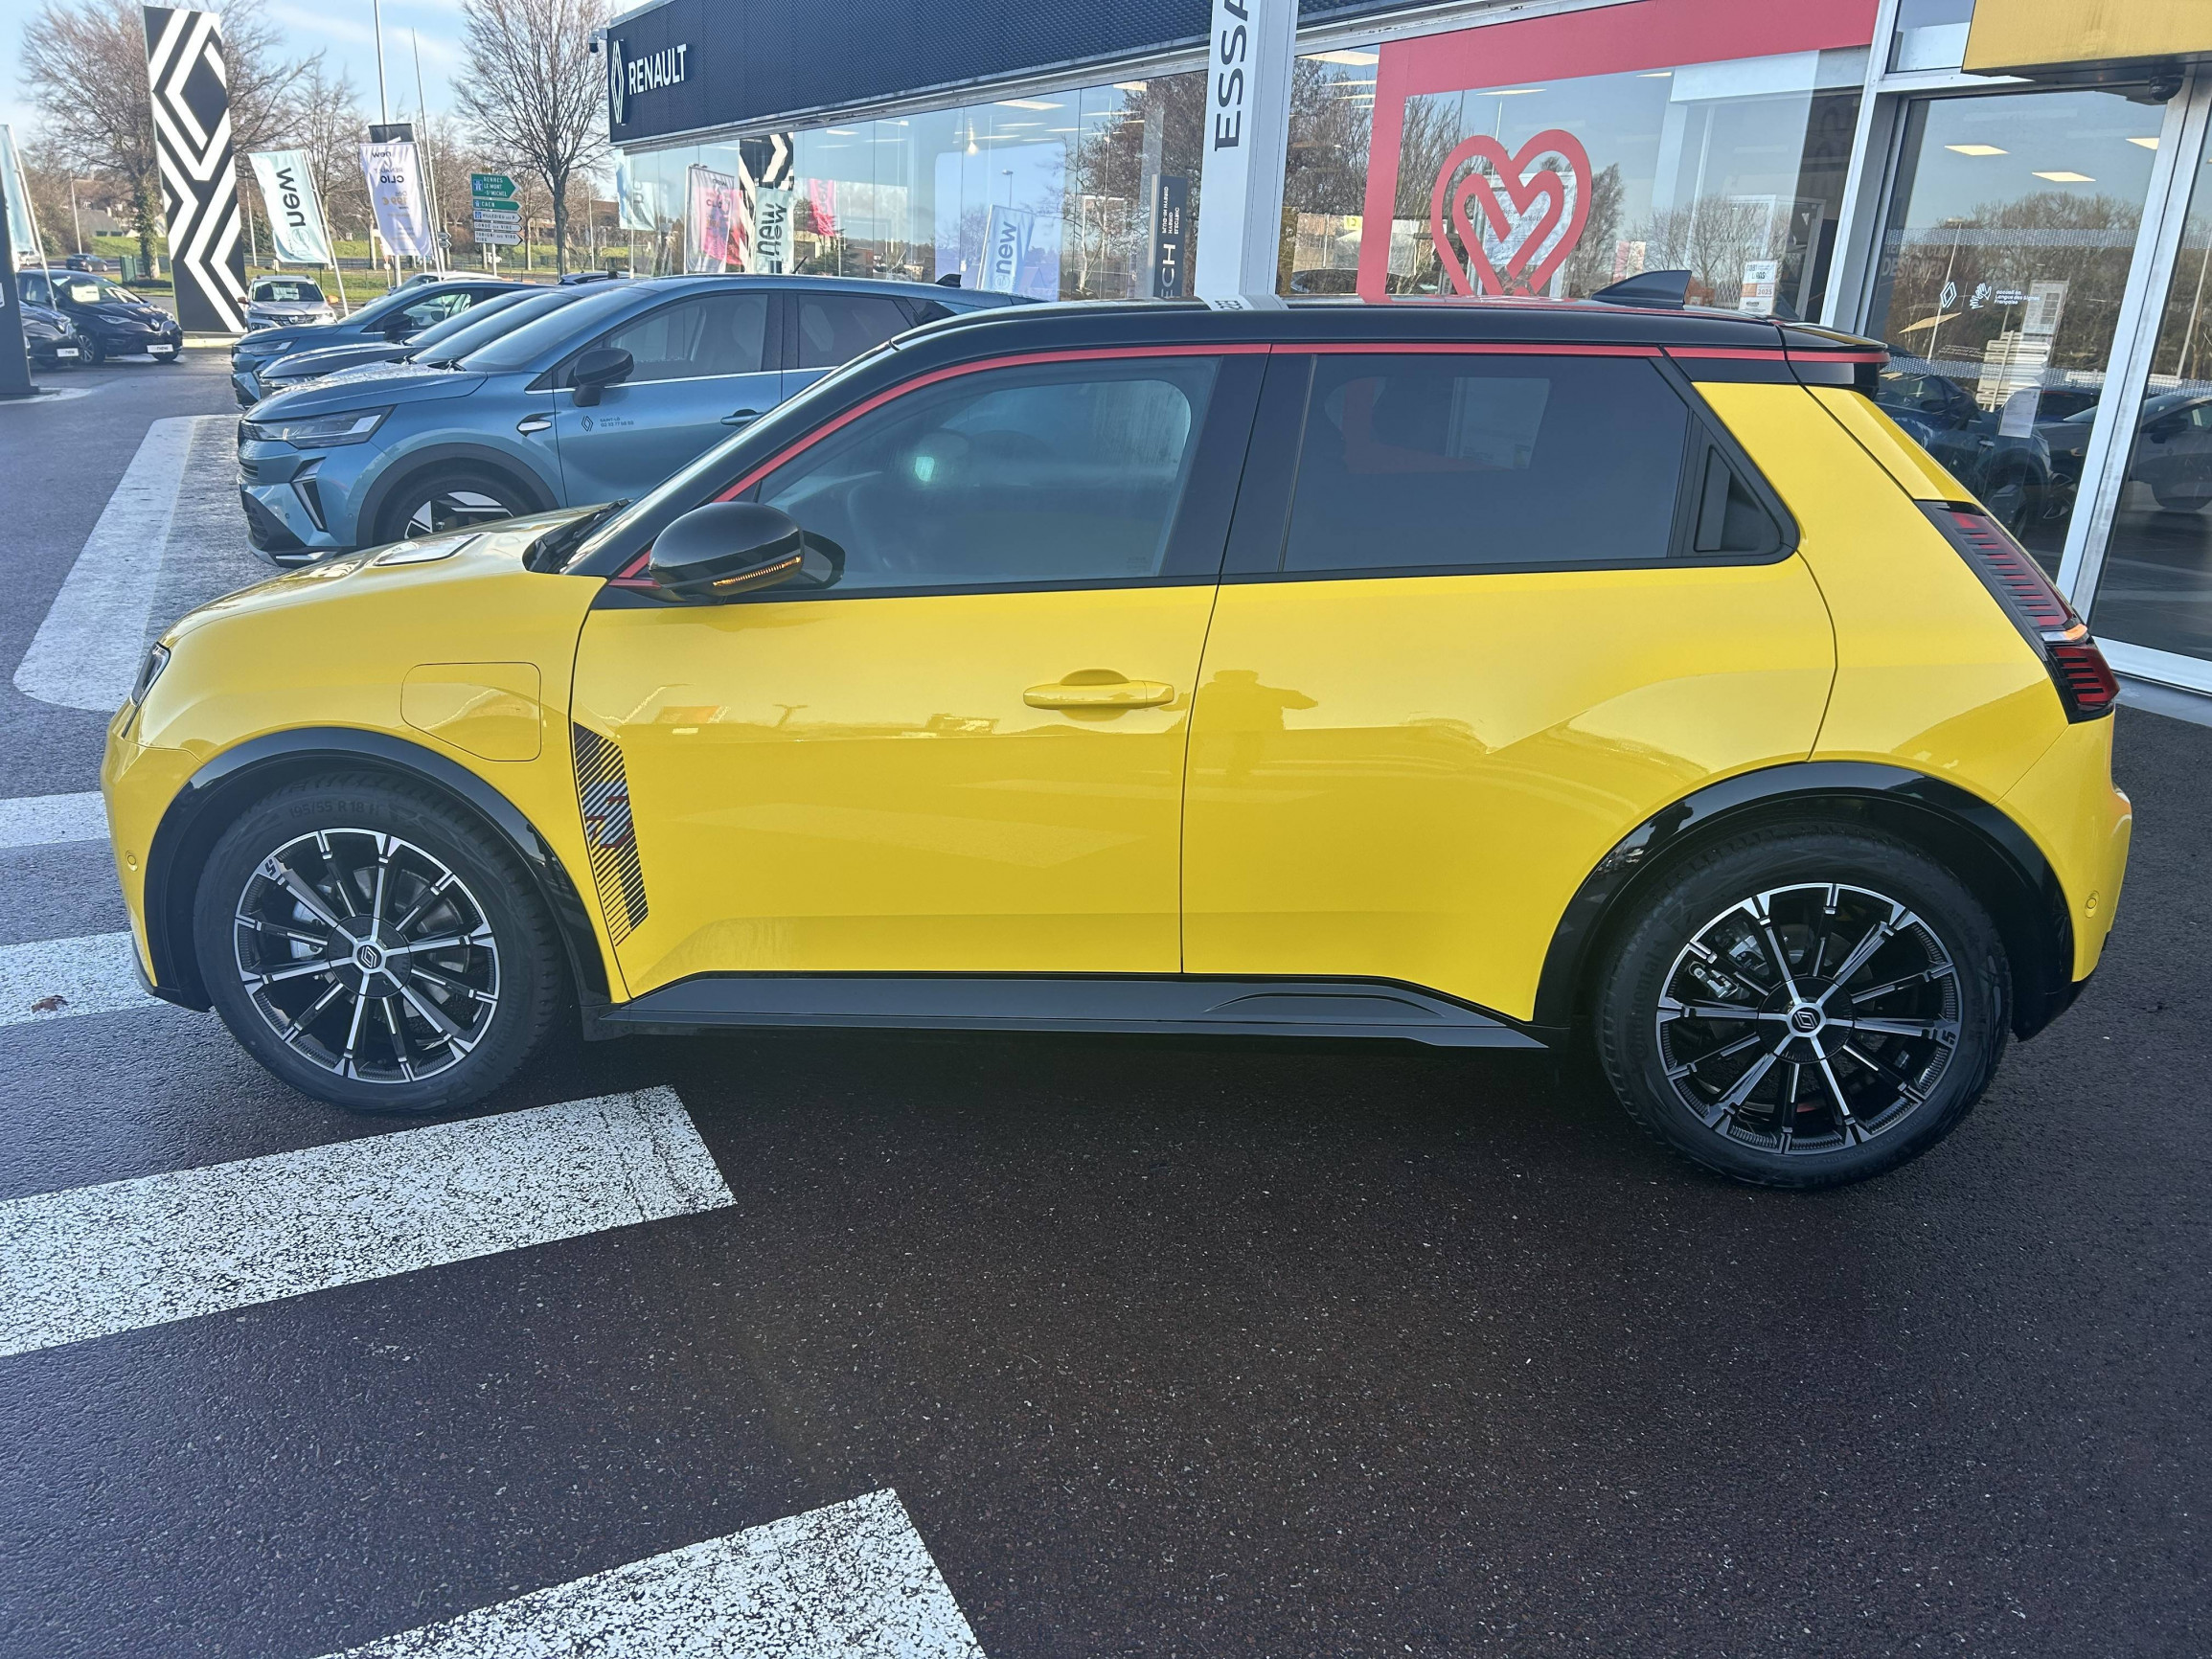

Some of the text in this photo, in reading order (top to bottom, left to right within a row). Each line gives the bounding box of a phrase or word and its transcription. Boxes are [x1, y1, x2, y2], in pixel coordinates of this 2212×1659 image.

[628, 44, 687, 96] RENAULT
[1881, 257, 1946, 281] DESIGNED
[289, 800, 333, 819] 195/55
[337, 801, 347, 812] R
[351, 801, 364, 813] 18
